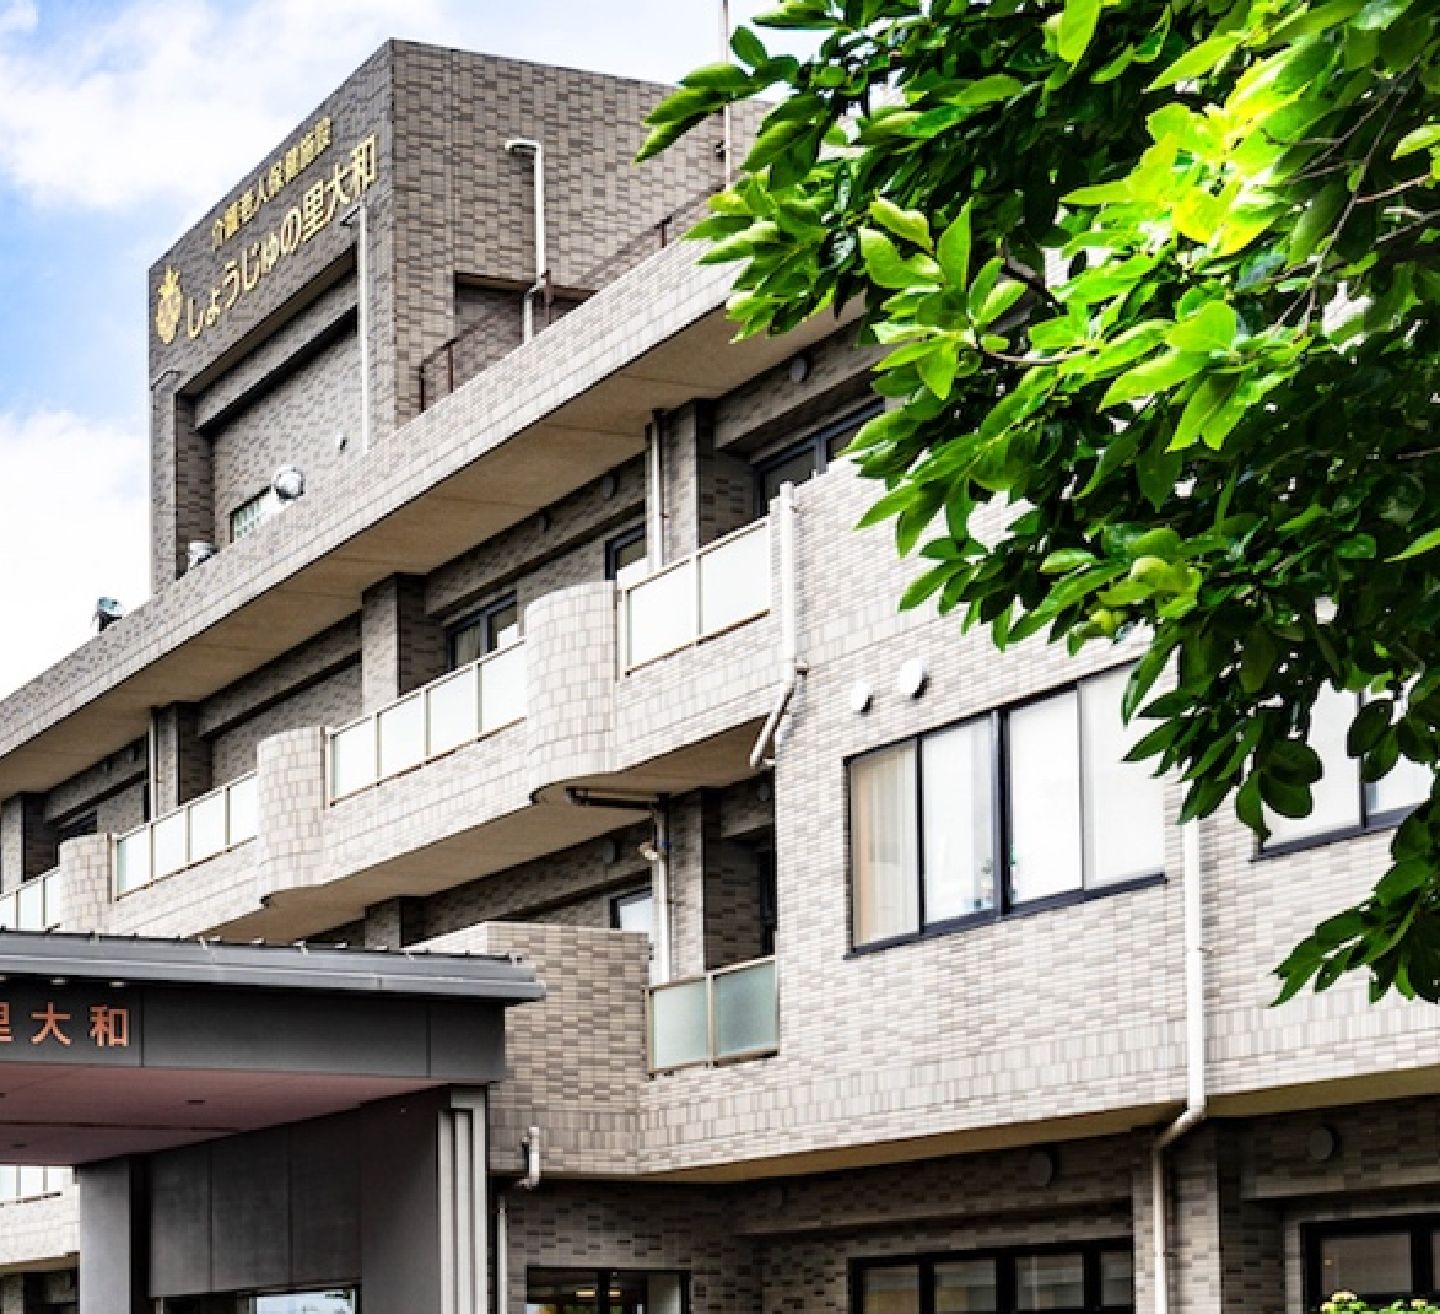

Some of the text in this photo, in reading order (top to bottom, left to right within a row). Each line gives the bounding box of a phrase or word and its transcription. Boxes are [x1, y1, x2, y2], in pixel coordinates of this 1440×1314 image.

[187, 134, 378, 338] しょうじゅの里大和
